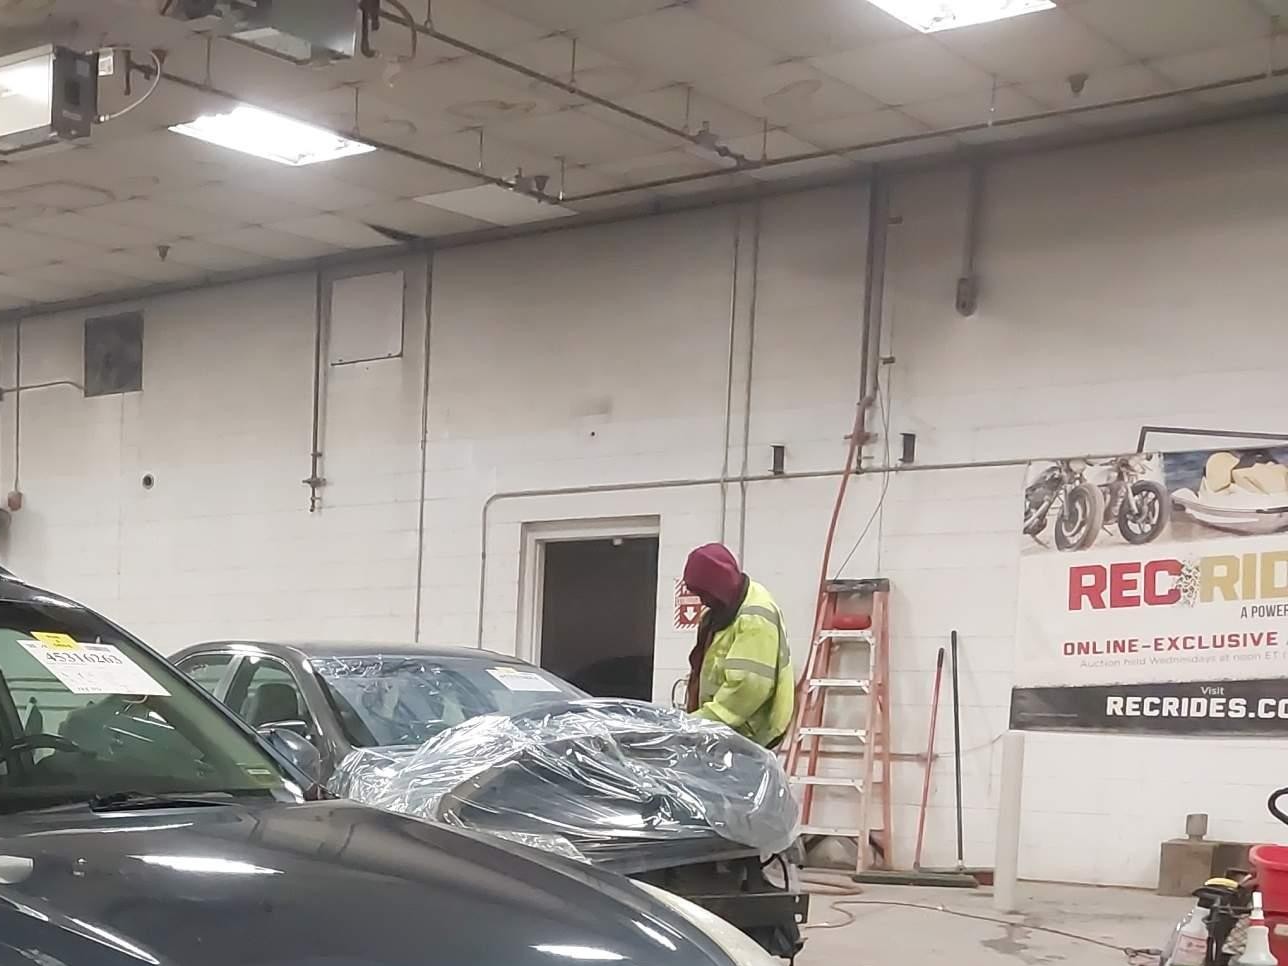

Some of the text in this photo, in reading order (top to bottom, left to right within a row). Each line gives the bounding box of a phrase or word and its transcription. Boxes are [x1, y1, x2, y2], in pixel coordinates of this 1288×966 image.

[1068, 559, 1184, 611] REC
[1241, 606, 1248, 619] A
[1063, 631, 1279, 656] ONLINE-EXCLUSIVE
[46, 651, 123, 664] 45316263
[1080, 659, 1121, 669] Auction
[1124, 657, 1146, 666] held
[1200, 686, 1225, 696] Visit
